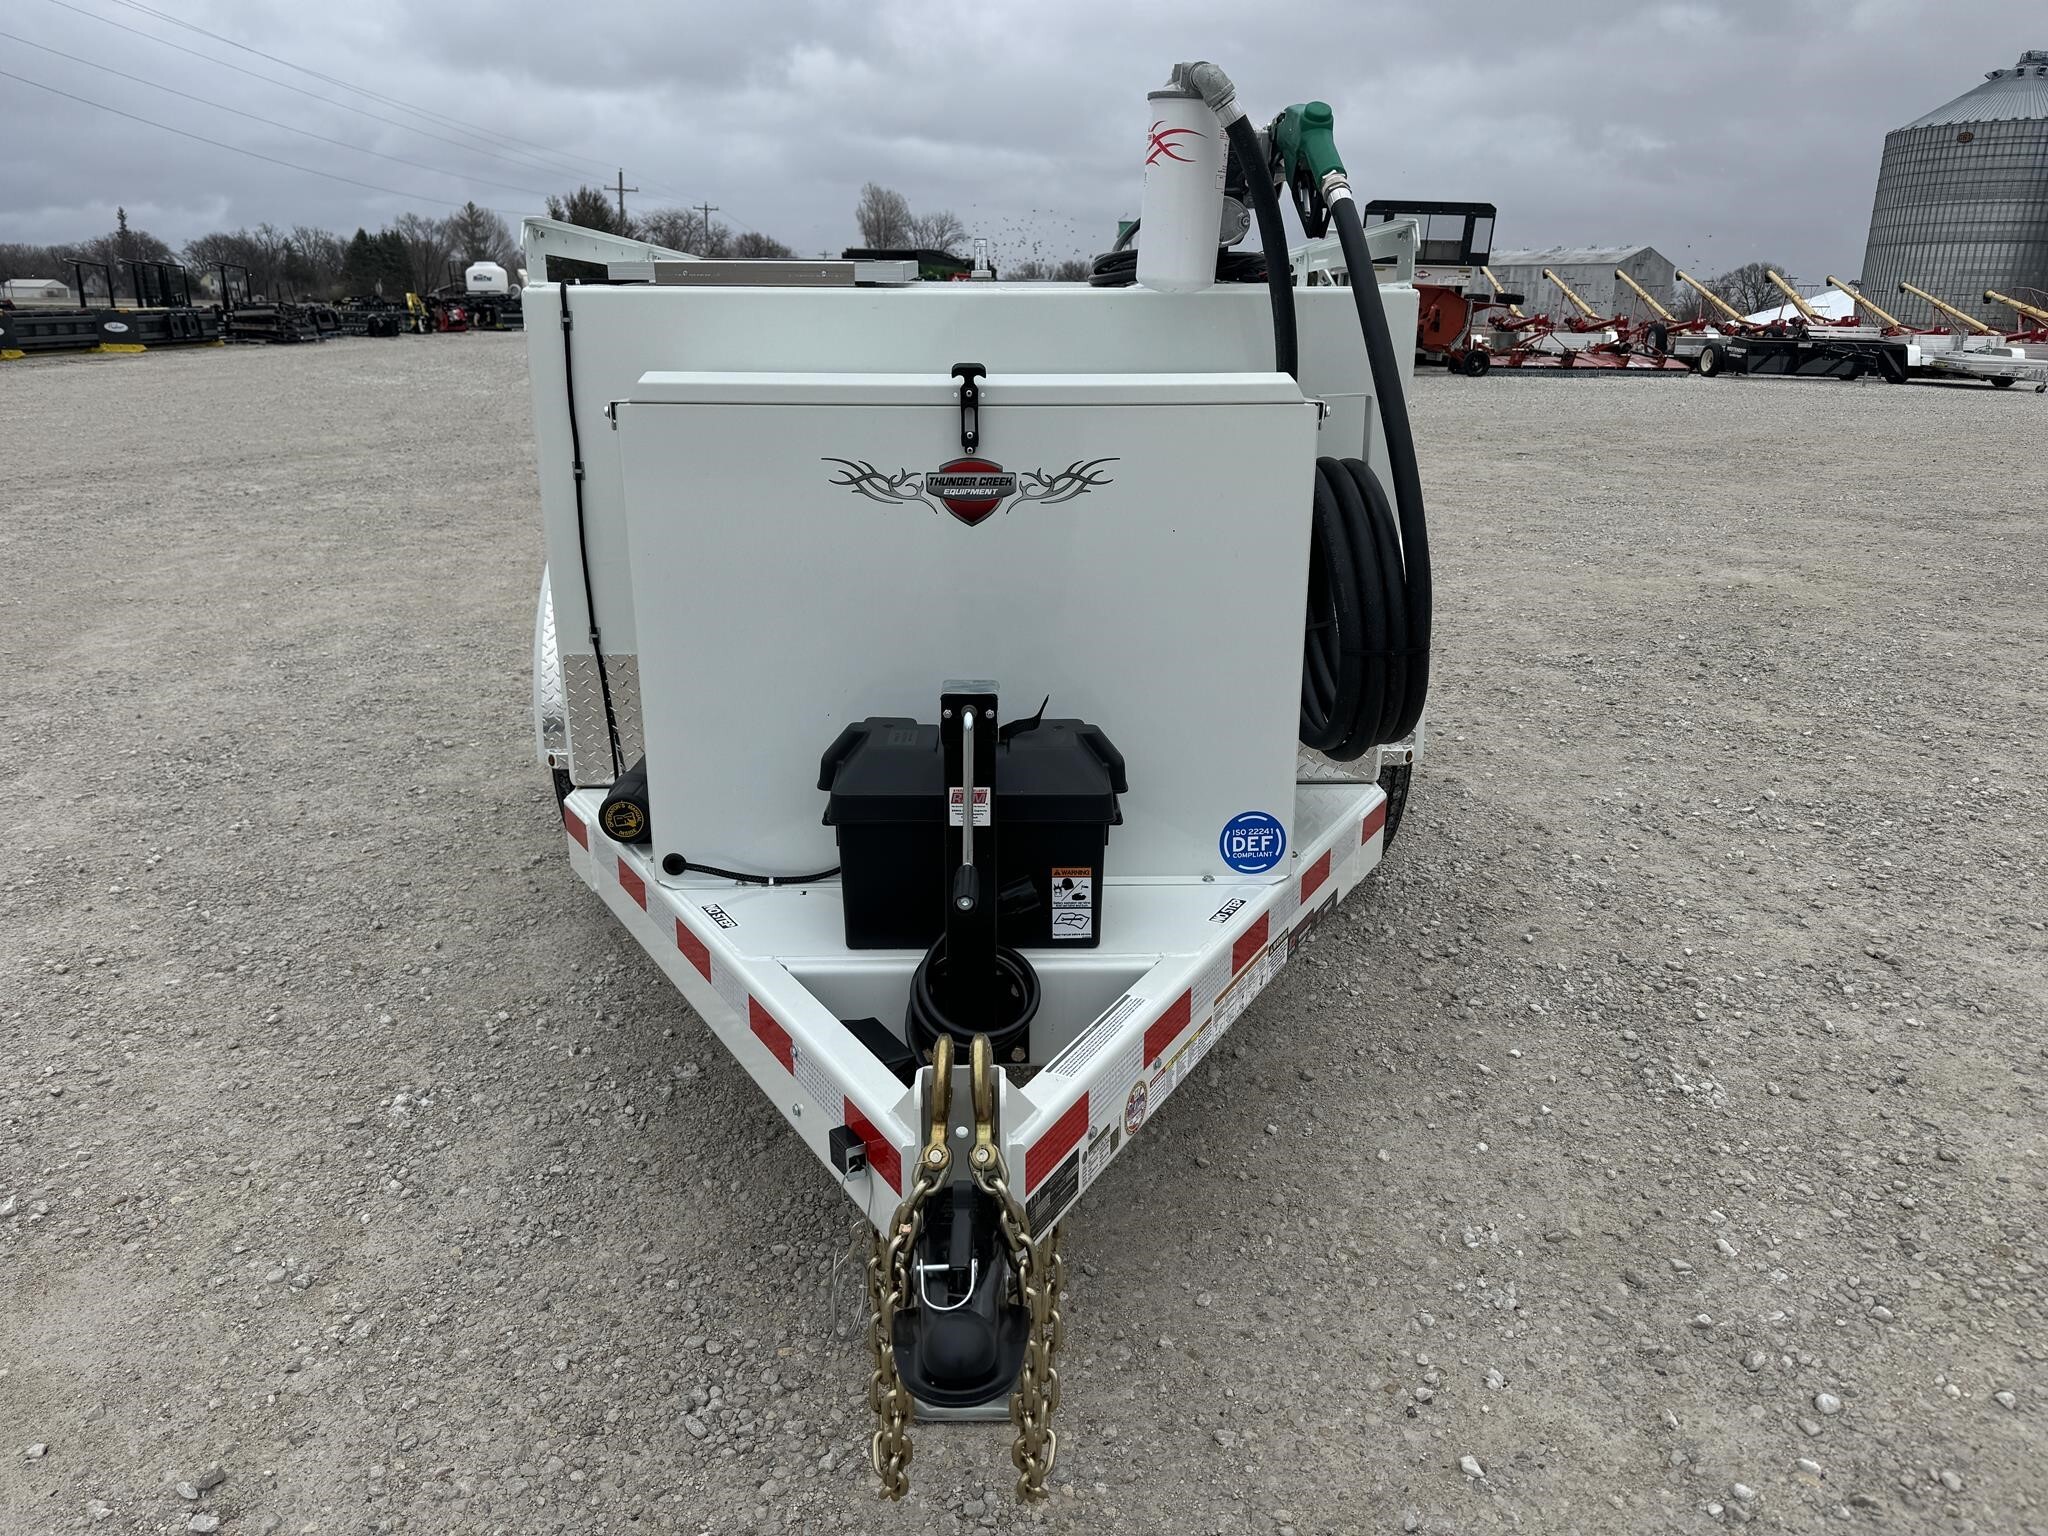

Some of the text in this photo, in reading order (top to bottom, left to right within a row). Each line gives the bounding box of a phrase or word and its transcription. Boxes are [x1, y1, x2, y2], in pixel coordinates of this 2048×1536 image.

[929, 477, 1013, 486] THUNDER CREEK
[951, 793, 987, 803] RM
[1232, 836, 1274, 852] DEF
[1232, 851, 1273, 859] COMPLIANT
[704, 904, 736, 928] NO STEP
[1210, 899, 1243, 924] NO STEP
